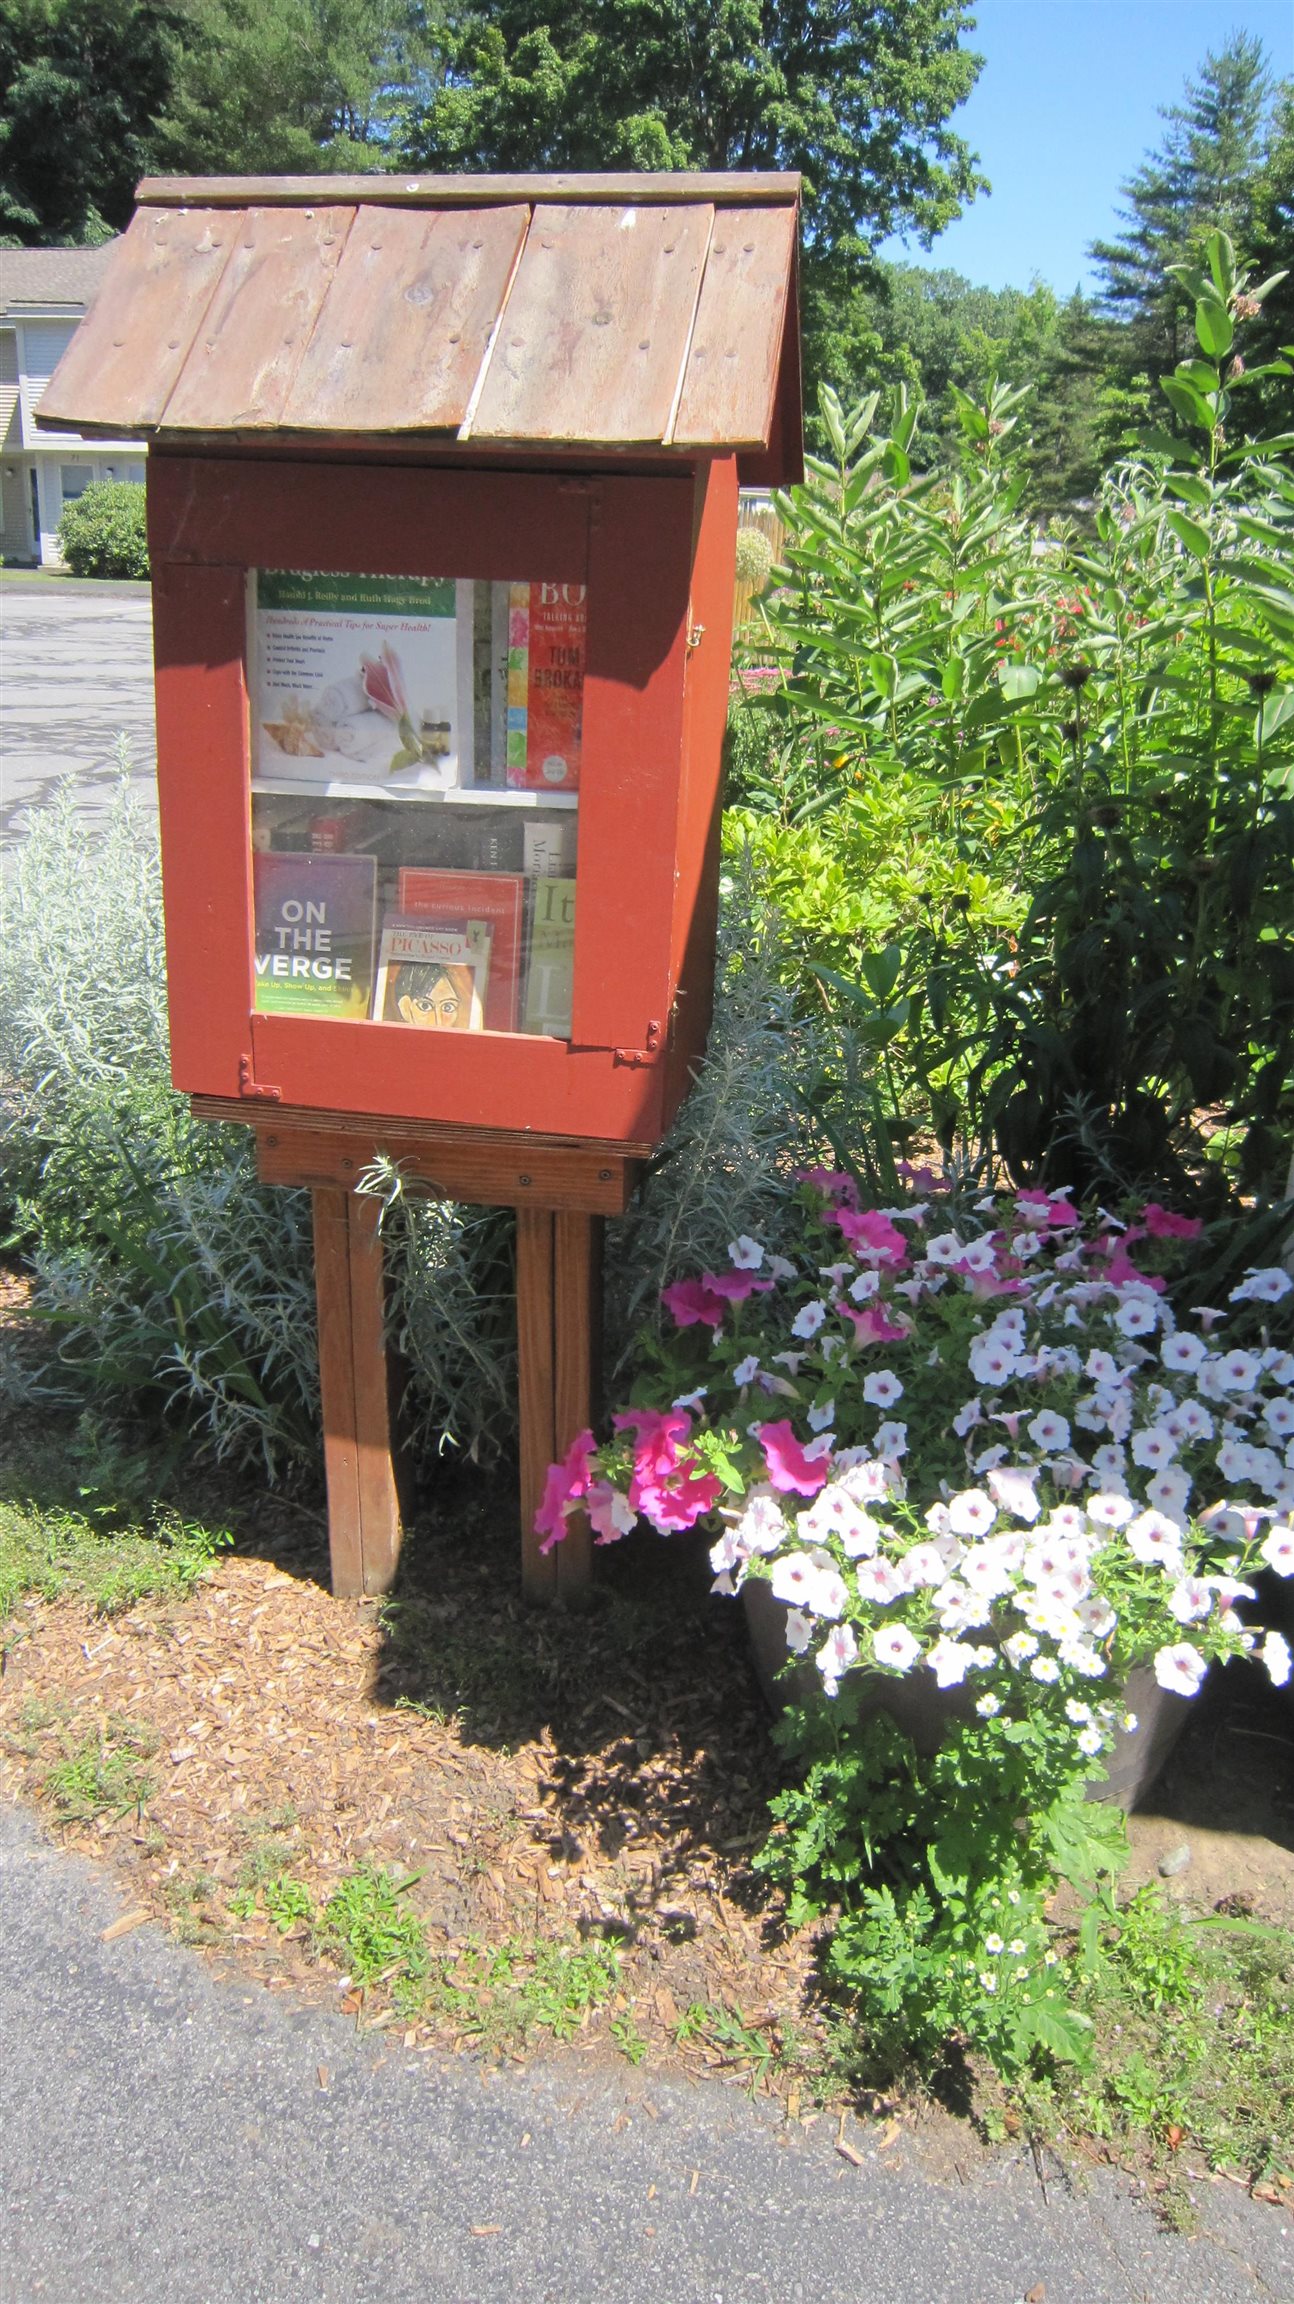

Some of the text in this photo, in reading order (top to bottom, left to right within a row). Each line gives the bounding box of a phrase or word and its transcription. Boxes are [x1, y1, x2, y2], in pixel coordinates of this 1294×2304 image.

[315, 591, 339, 602] Reilly
[340, 593, 358, 602] and
[543, 611, 572, 622] TALKING
[309, 618, 343, 628] Practical
[344, 619, 360, 630] Tips
[375, 621, 399, 632] Super
[400, 621, 432, 632] Health!
[549, 647, 579, 665] TOM
[282, 899, 327, 924] ON
[415, 901, 505, 914] the curious incident
[274, 926, 332, 952] THE
[391, 937, 462, 955] PICASSO
[254, 953, 353, 981] VERGE
[304, 983, 317, 992] Up,
